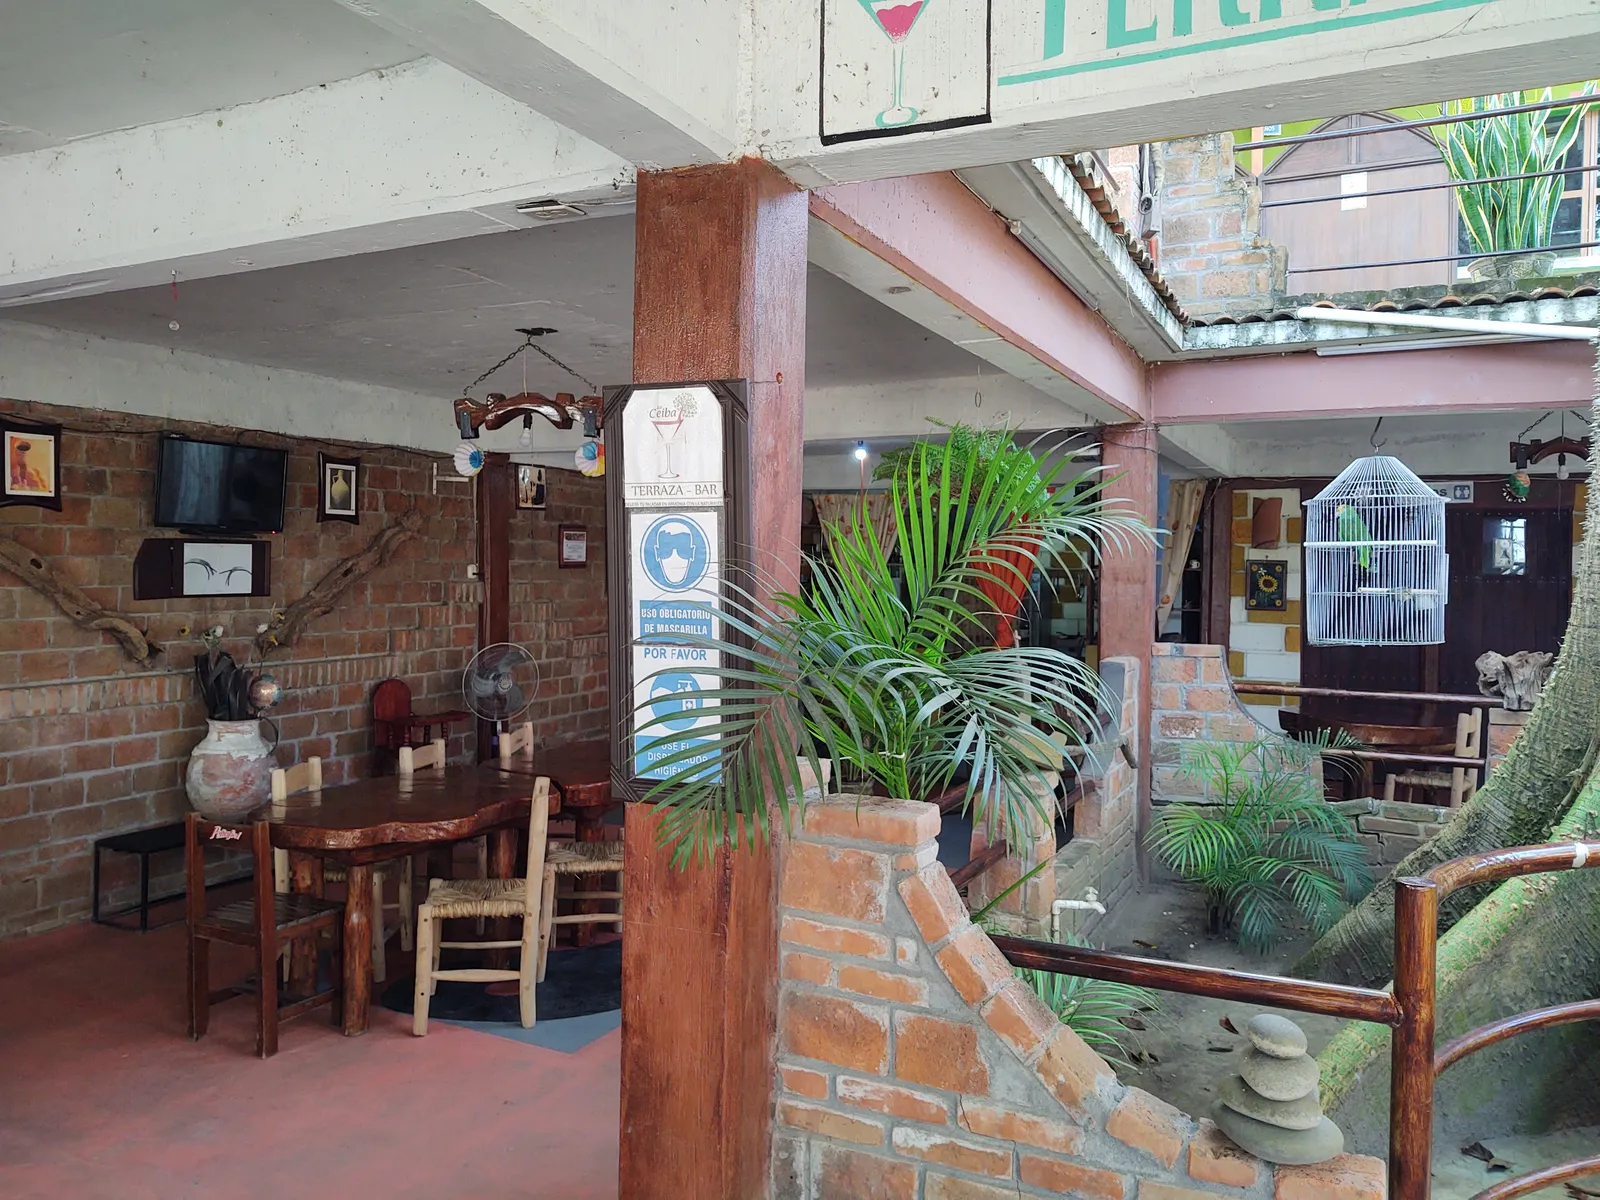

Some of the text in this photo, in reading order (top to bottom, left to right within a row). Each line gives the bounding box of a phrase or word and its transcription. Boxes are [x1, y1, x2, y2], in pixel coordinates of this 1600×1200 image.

[649, 407, 677, 419] Ceiba
[631, 485, 684, 496] TERRAZA
[695, 484, 717, 495] BAR
[641, 608, 711, 619] USO OBLIGATORIO
[644, 623, 708, 635] DE MASCARILLA
[643, 647, 707, 661] POR FAVOR
[661, 742, 678, 750] USE
